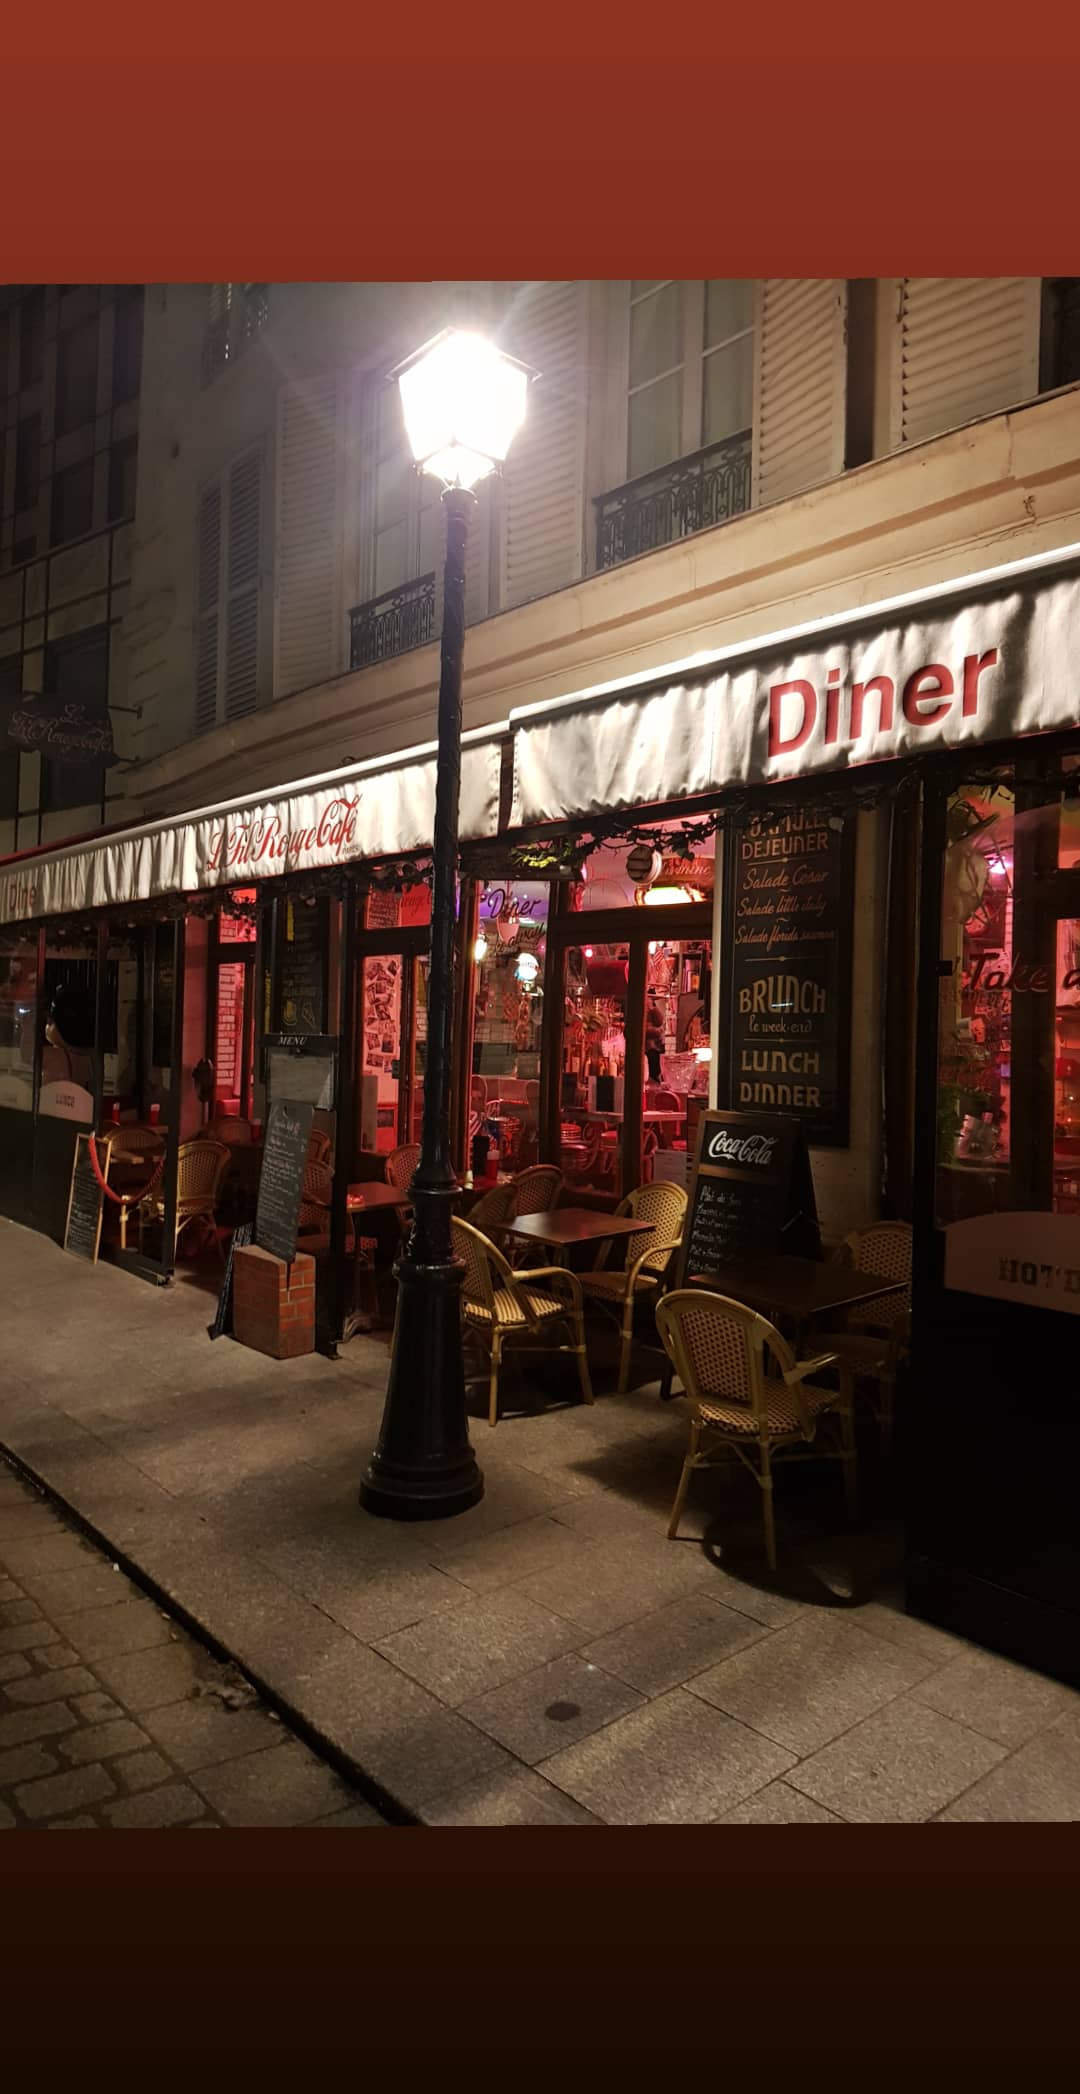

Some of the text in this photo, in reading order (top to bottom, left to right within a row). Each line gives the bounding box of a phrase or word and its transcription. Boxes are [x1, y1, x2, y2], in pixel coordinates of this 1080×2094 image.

[768, 648, 998, 758] Diner
[742, 831, 829, 860] DEJEUNER
[743, 867, 790, 890] Salade
[488, 888, 542, 919] Diner
[736, 896, 775, 917] Salade
[734, 926, 769, 945] Salade
[962, 952, 1049, 993] Take
[739, 975, 828, 1015] BRUNCH
[278, 1035, 309, 1047] MENU
[741, 1050, 821, 1075] LUNCH
[739, 1081, 822, 1108] DINNER
